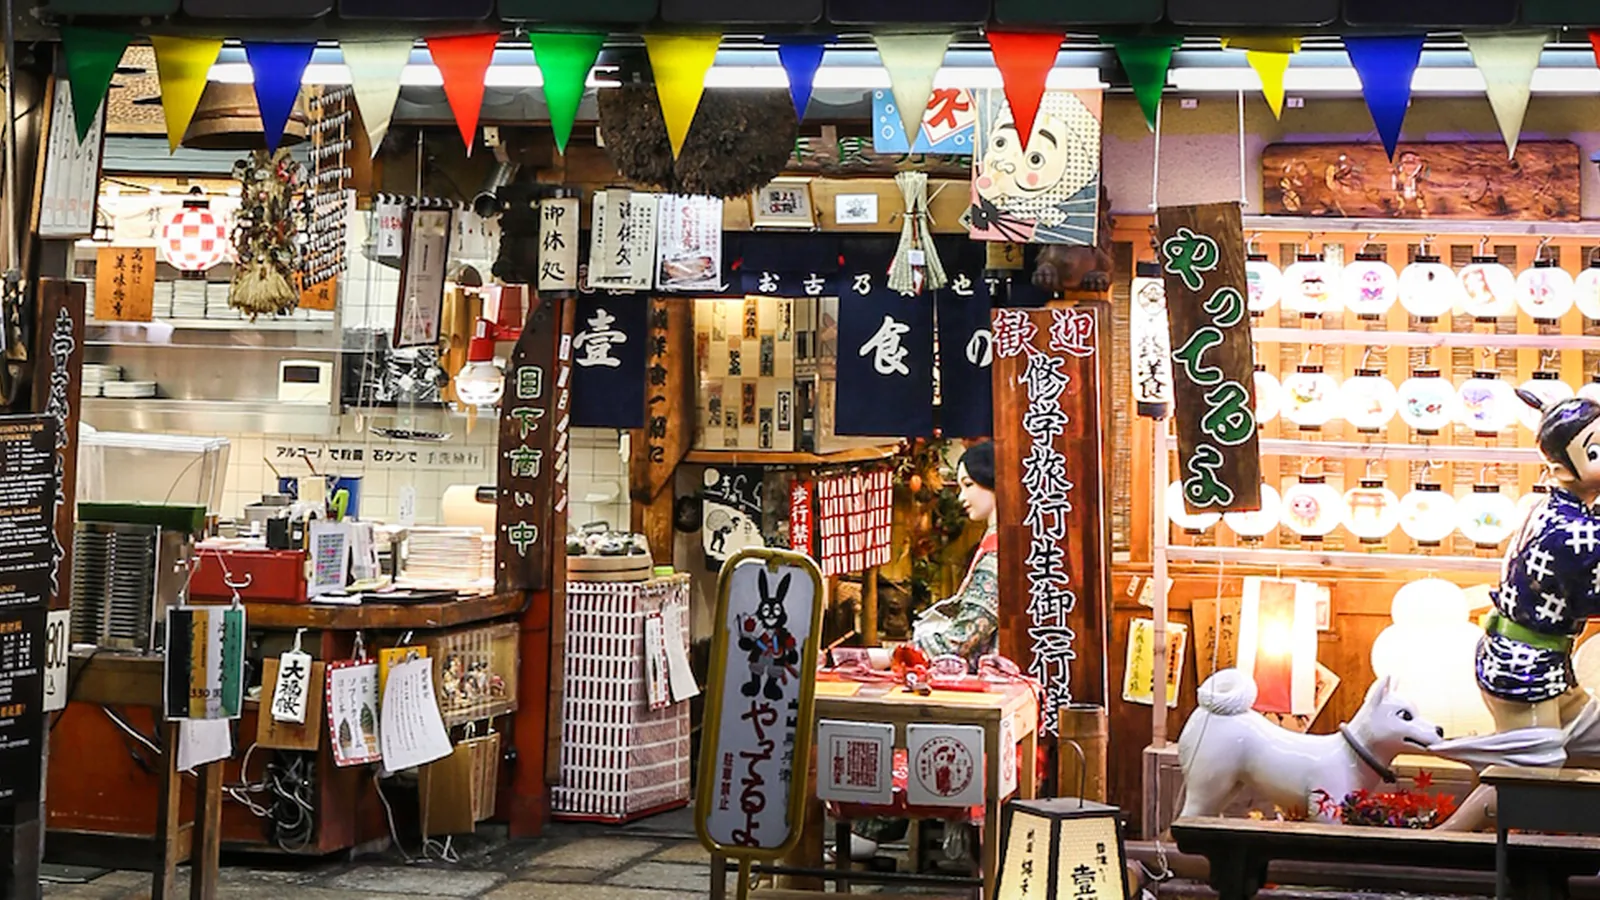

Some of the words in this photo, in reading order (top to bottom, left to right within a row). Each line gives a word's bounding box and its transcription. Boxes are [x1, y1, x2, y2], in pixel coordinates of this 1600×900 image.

[541, 203, 566, 281] 御休処
[572, 309, 628, 368] 壹
[859, 316, 911, 376] 食
[989, 307, 1098, 356] 歓迎
[1163, 228, 1255, 508] やってるよ
[508, 366, 546, 557] 目下商い中
[273, 659, 304, 716] 大福帳
[731, 699, 779, 847] やってるよ
[1070, 863, 1098, 900] 壹
